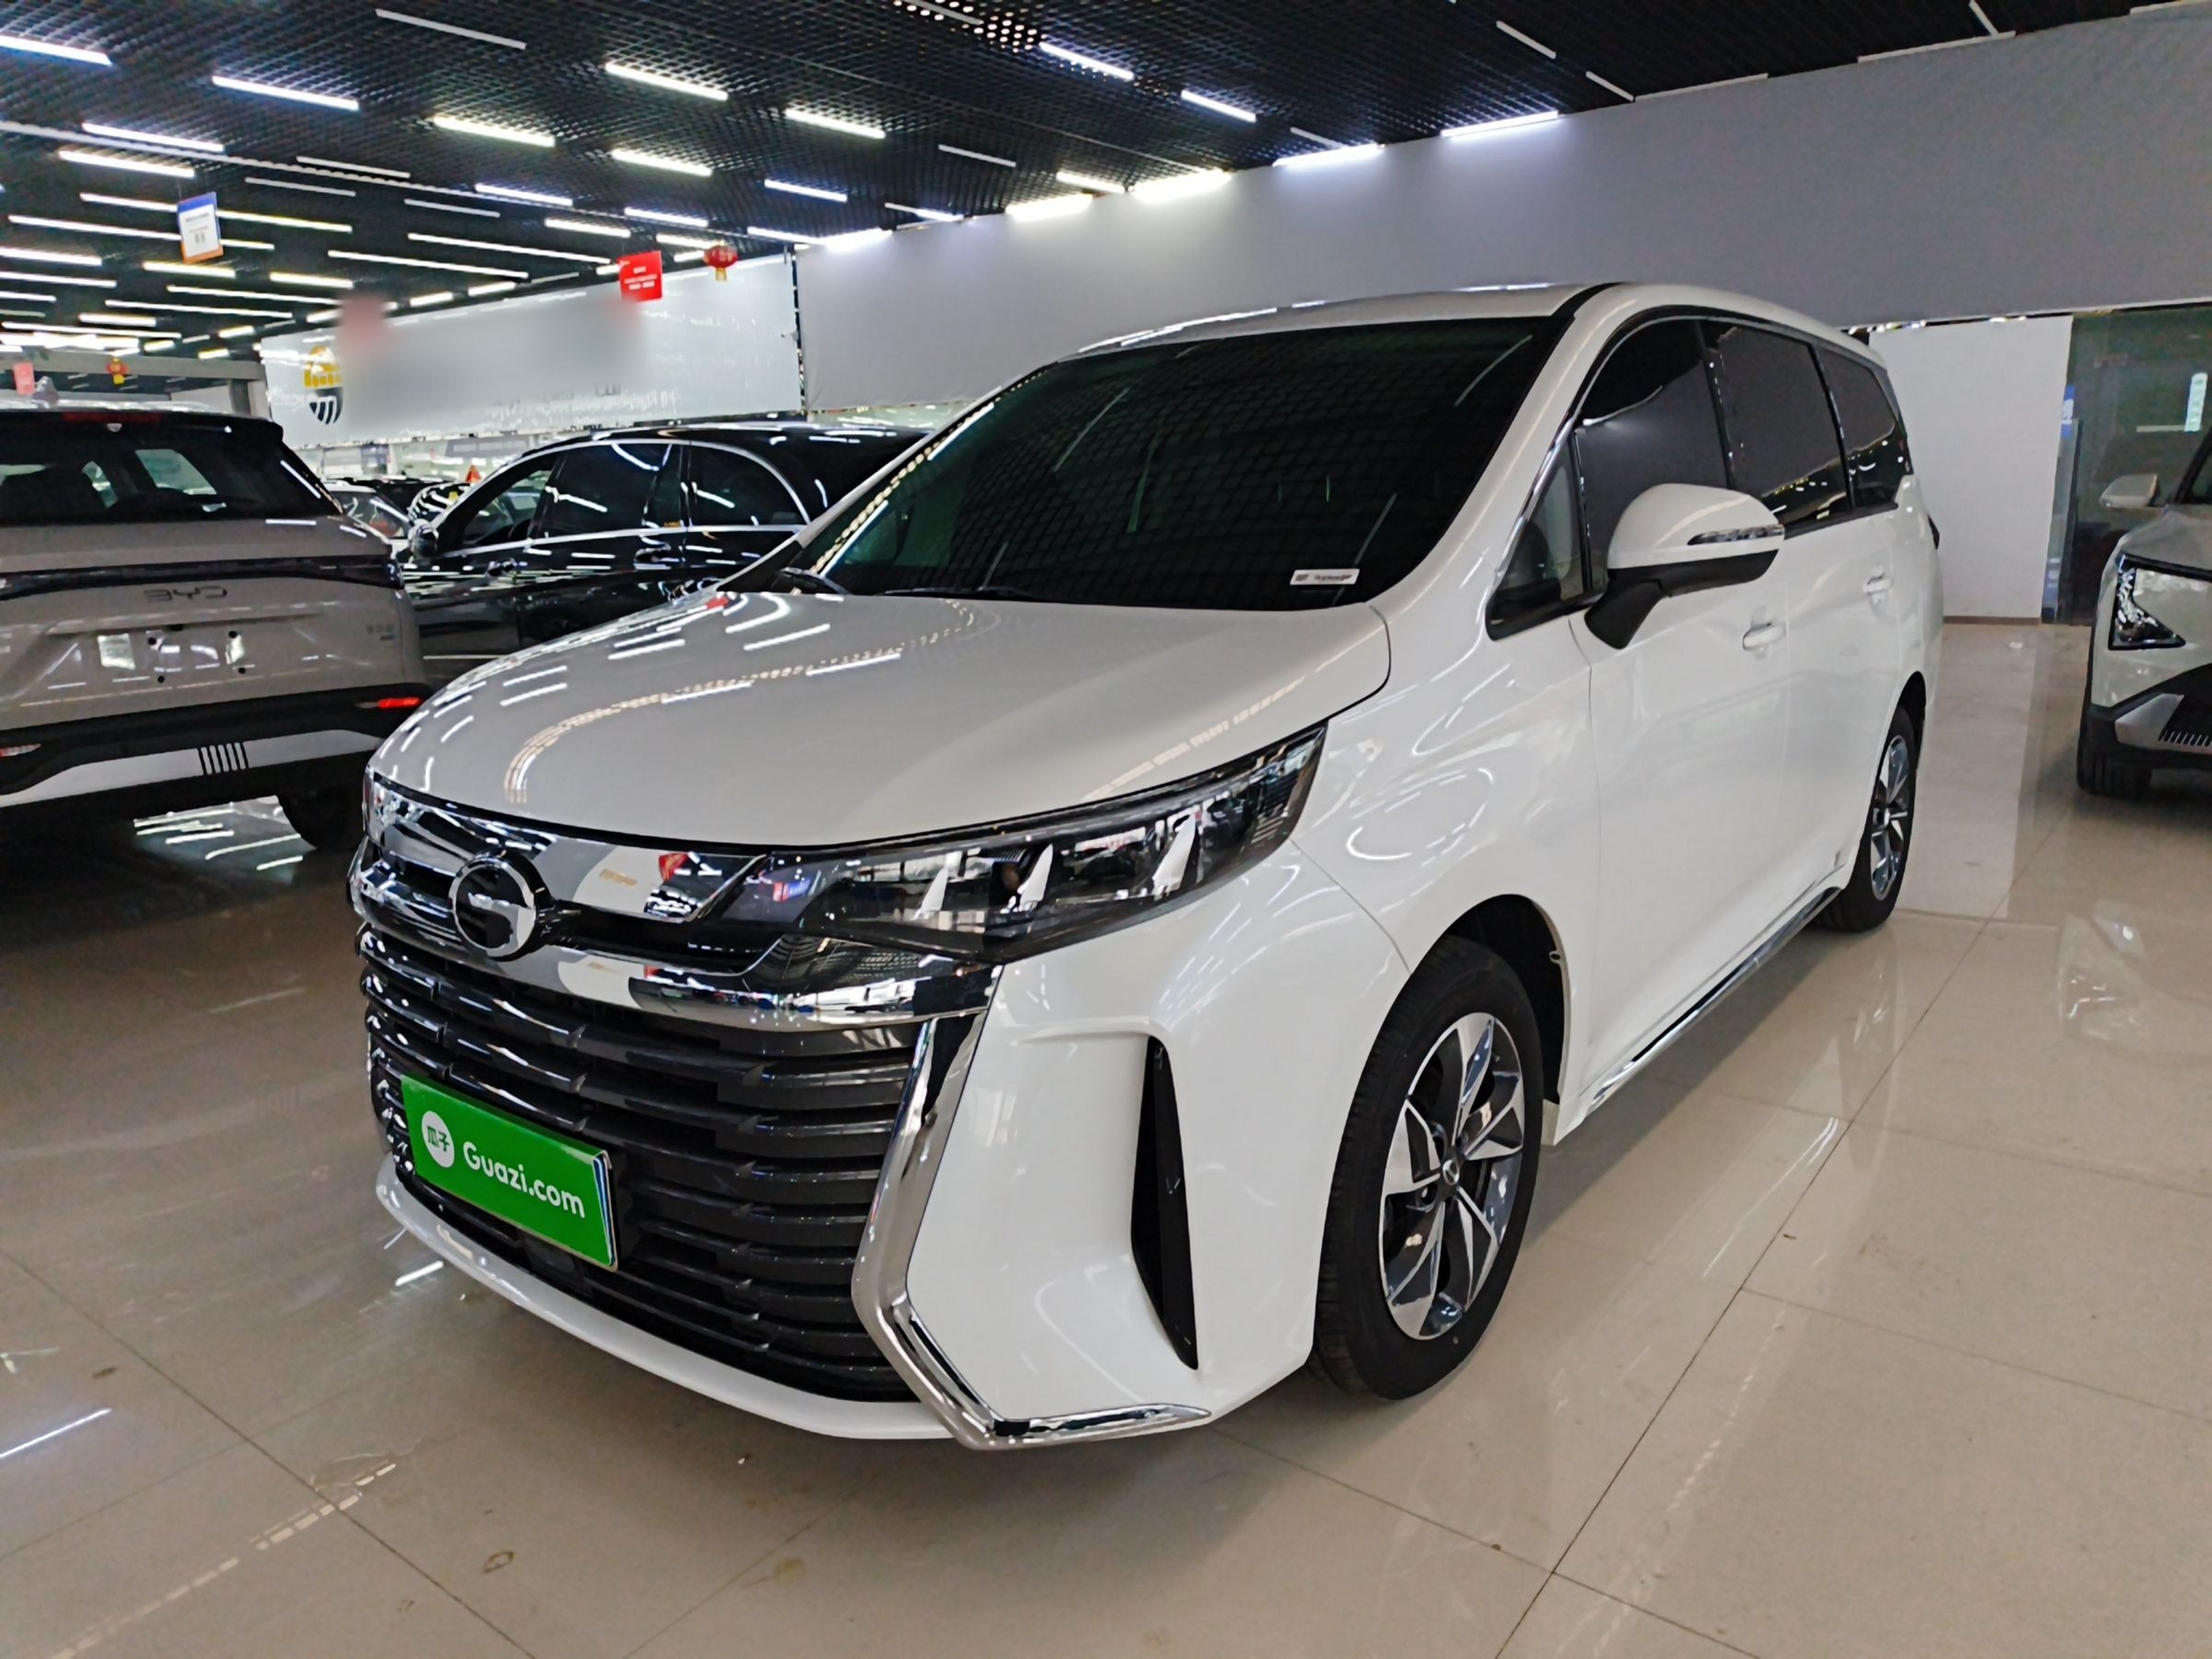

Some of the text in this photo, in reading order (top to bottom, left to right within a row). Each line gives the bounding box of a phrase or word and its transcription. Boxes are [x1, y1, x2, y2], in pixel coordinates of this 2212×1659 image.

[143, 585, 228, 603] BYD
[426, 1125, 449, 1152] 瓜子
[463, 1141, 585, 1218] Guazi.com
